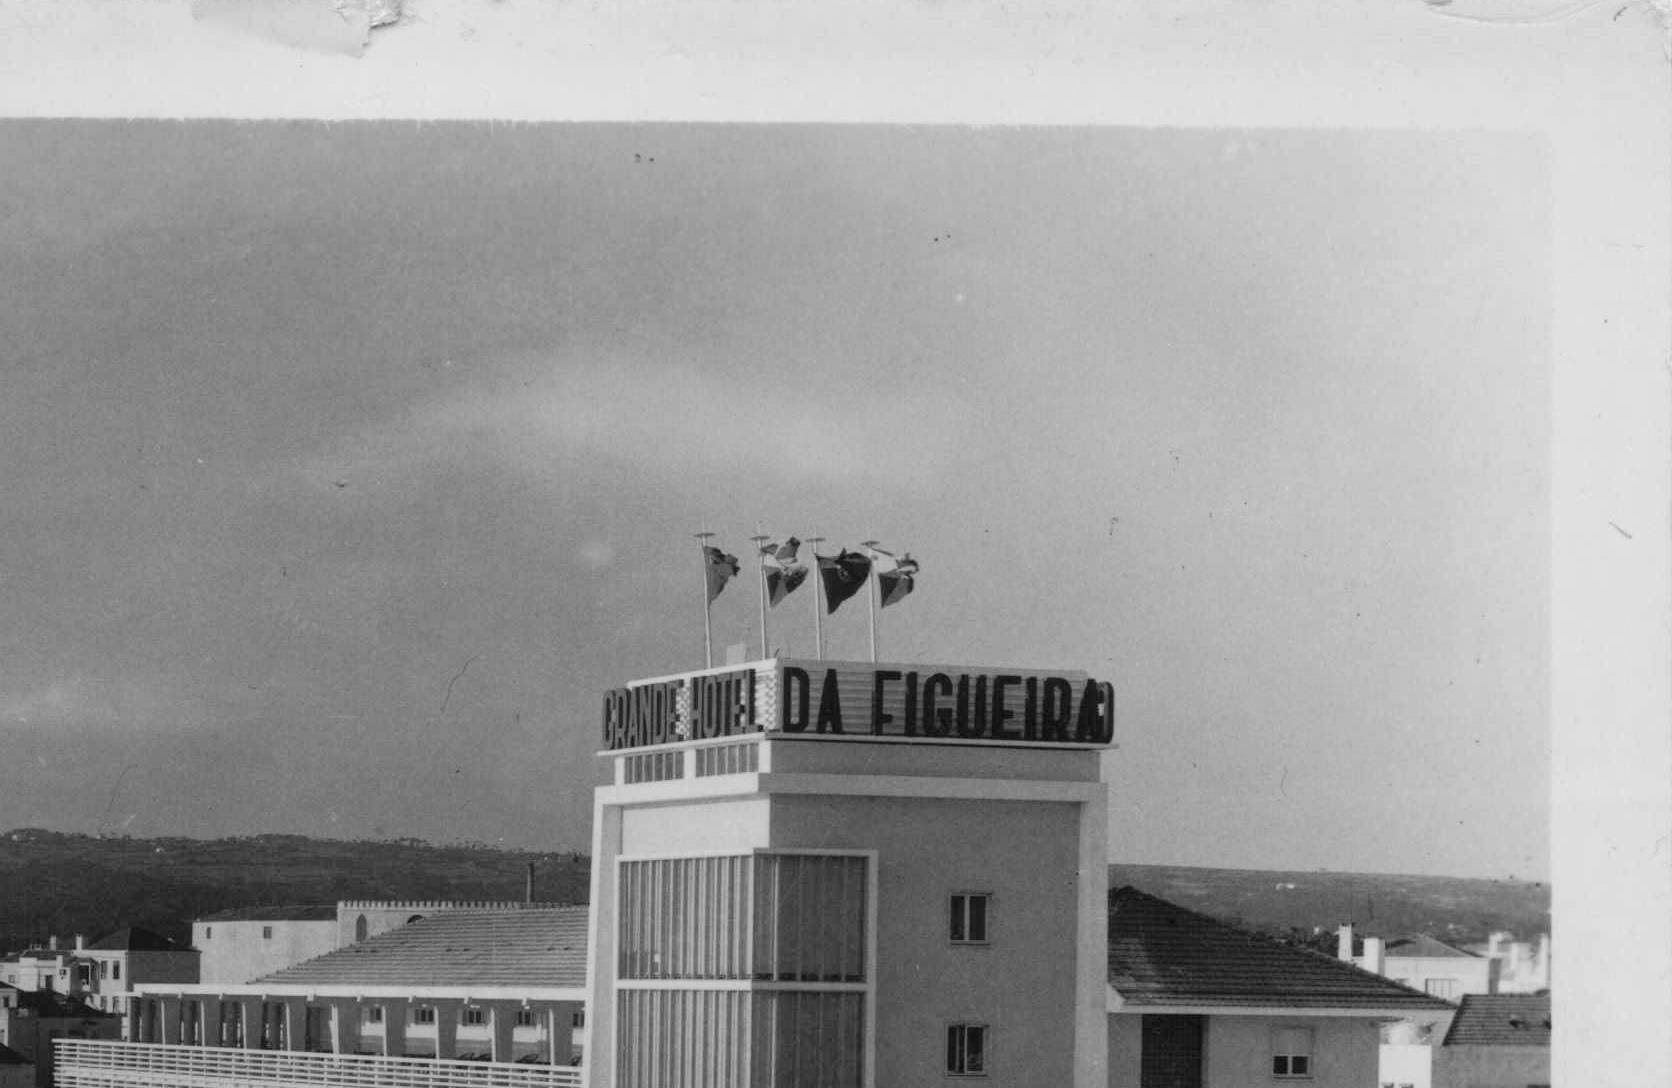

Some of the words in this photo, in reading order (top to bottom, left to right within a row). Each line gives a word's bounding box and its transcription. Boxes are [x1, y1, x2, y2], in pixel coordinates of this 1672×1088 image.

[602, 679, 684, 749] GRANDE
[690, 669, 764, 741] HOTEL
[783, 667, 842, 734] DA
[871, 671, 1106, 742] FIGUEIRA
